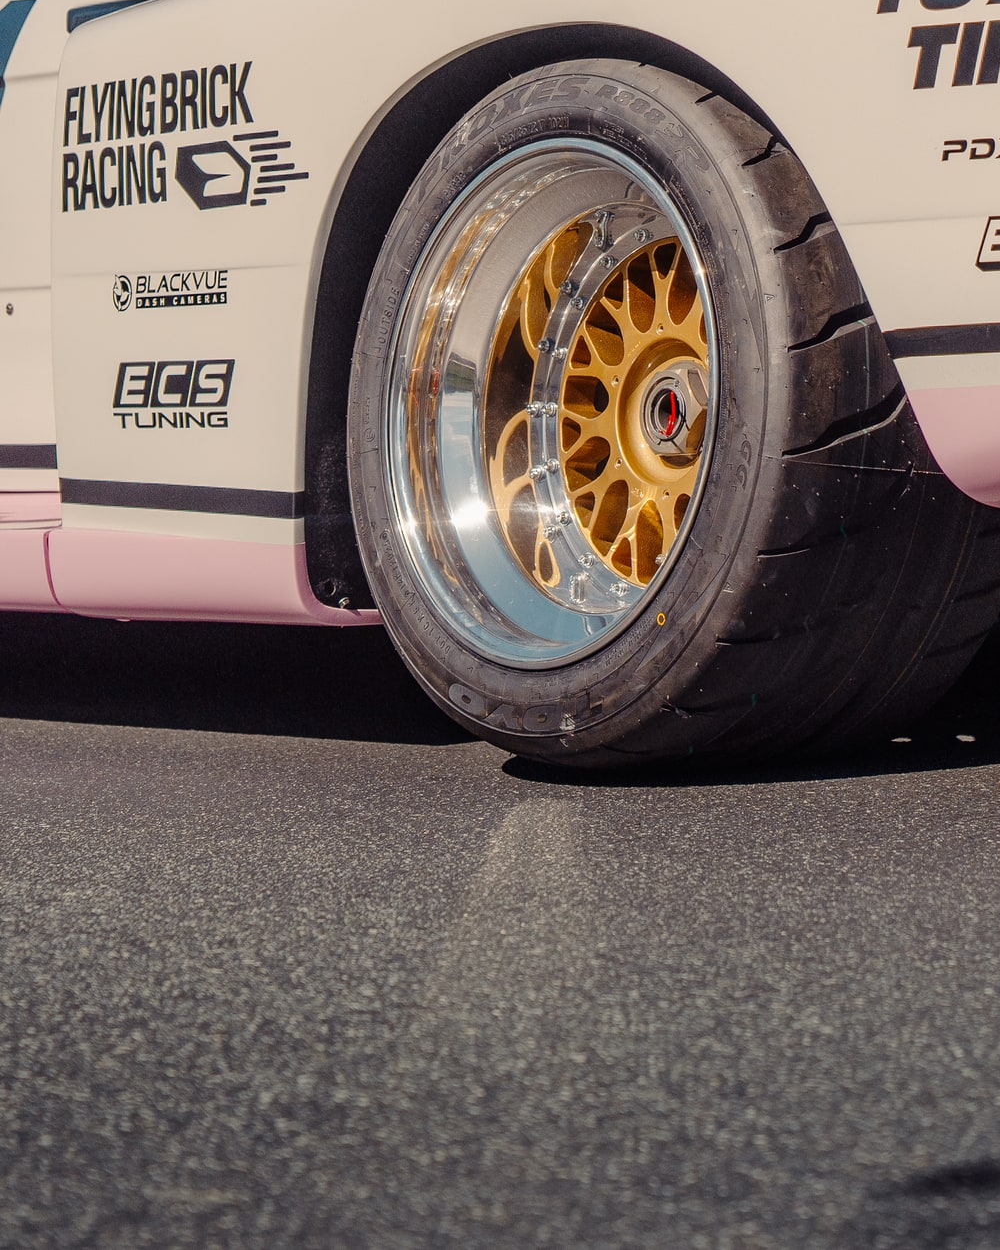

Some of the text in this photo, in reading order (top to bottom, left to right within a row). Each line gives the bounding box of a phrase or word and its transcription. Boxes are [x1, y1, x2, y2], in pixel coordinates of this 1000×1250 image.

[63, 61, 253, 147] FLYING BRICK
[62, 141, 167, 213] RACING
[136, 270, 228, 294] BLACKVUE
[137, 293, 226, 307] DASH CAMERAS
[377, 287, 400, 347] OUTSIDE
[113, 359, 235, 408] ECS
[113, 412, 229, 429] TUNING
